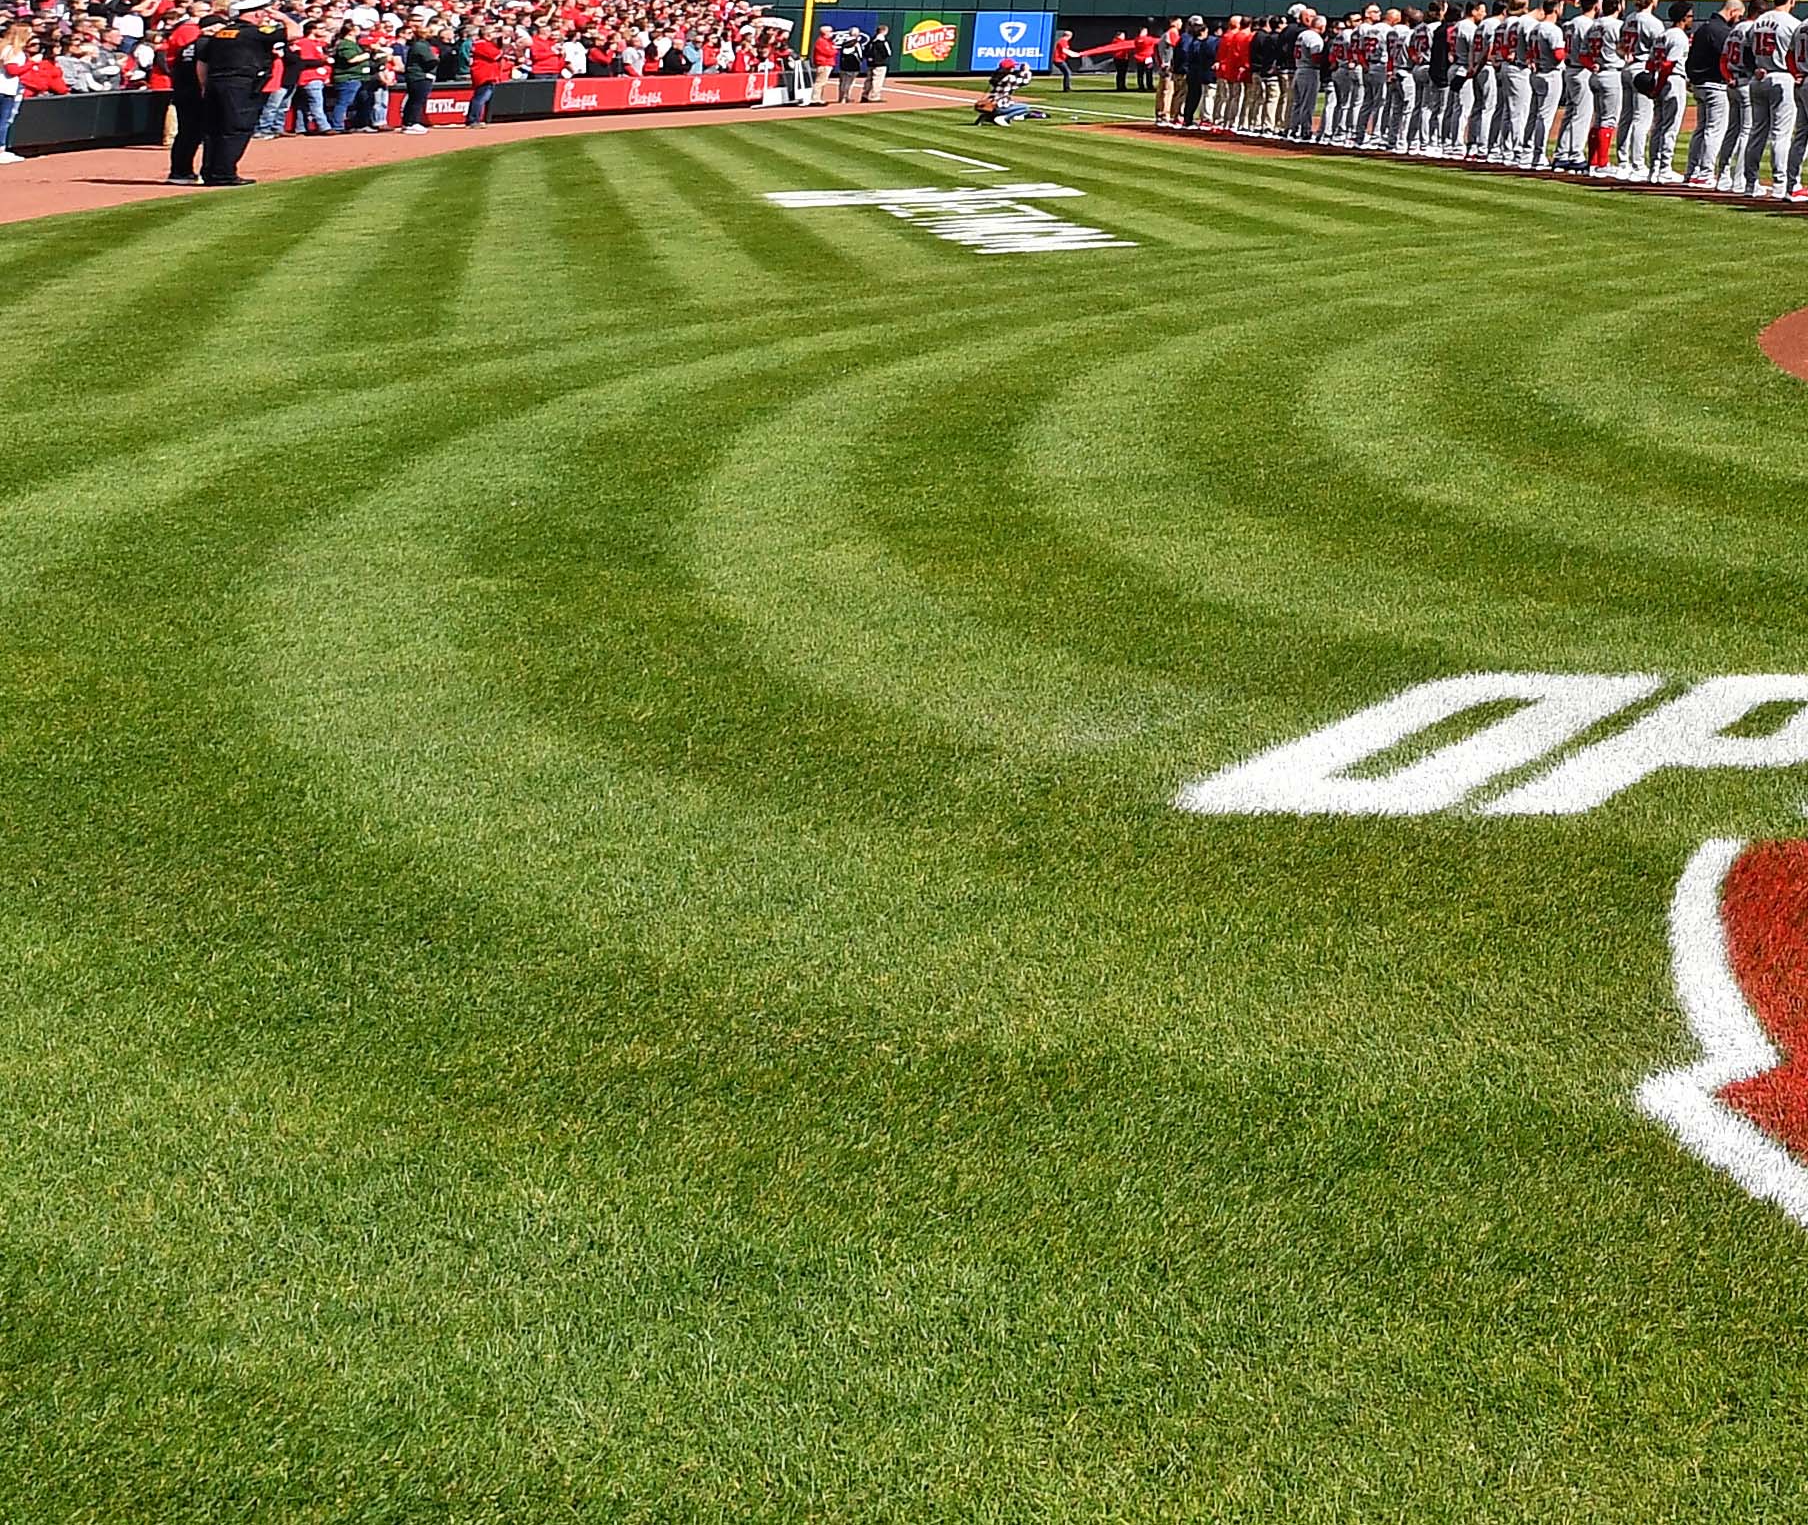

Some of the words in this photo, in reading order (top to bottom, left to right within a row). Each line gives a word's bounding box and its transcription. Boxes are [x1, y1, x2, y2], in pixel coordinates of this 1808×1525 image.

[906, 27, 957, 50] Kahn's
[1754, 32, 1777, 56] 15
[977, 47, 1043, 59] FANDUEL
